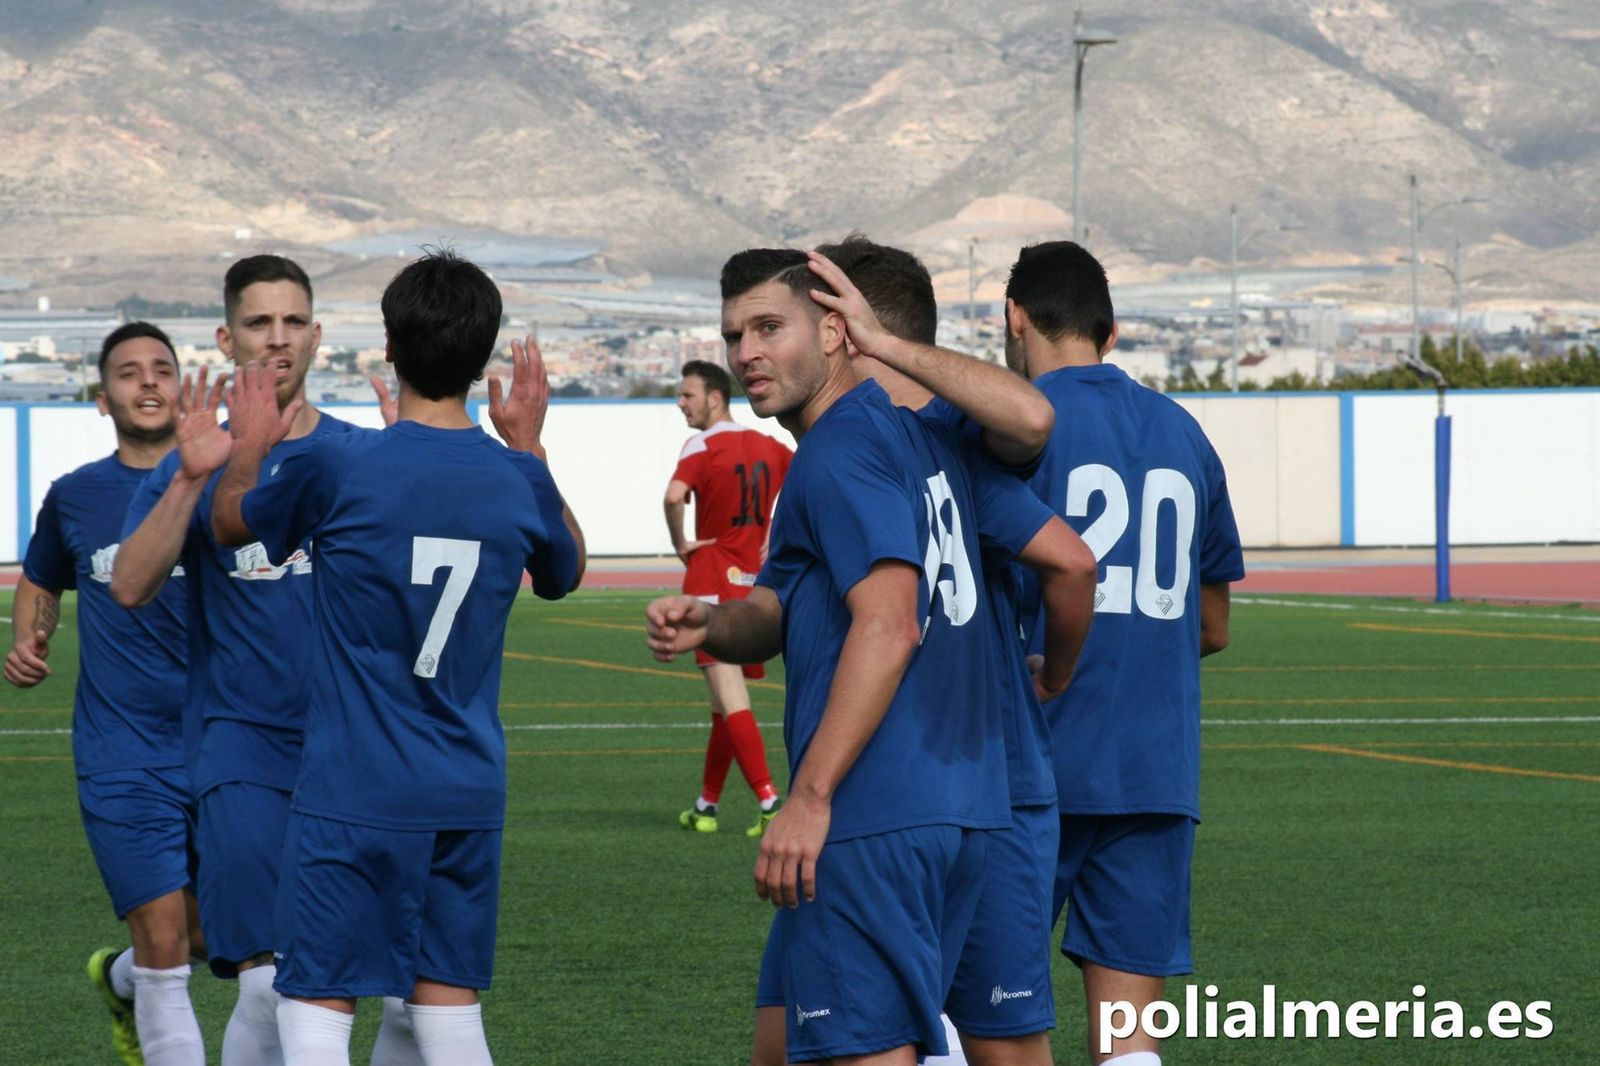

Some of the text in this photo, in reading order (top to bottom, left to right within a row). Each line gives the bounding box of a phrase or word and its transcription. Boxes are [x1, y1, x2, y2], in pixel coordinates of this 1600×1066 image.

[731, 460, 770, 527] 10
[1066, 464, 1196, 619] 20
[411, 536, 481, 678] 7
